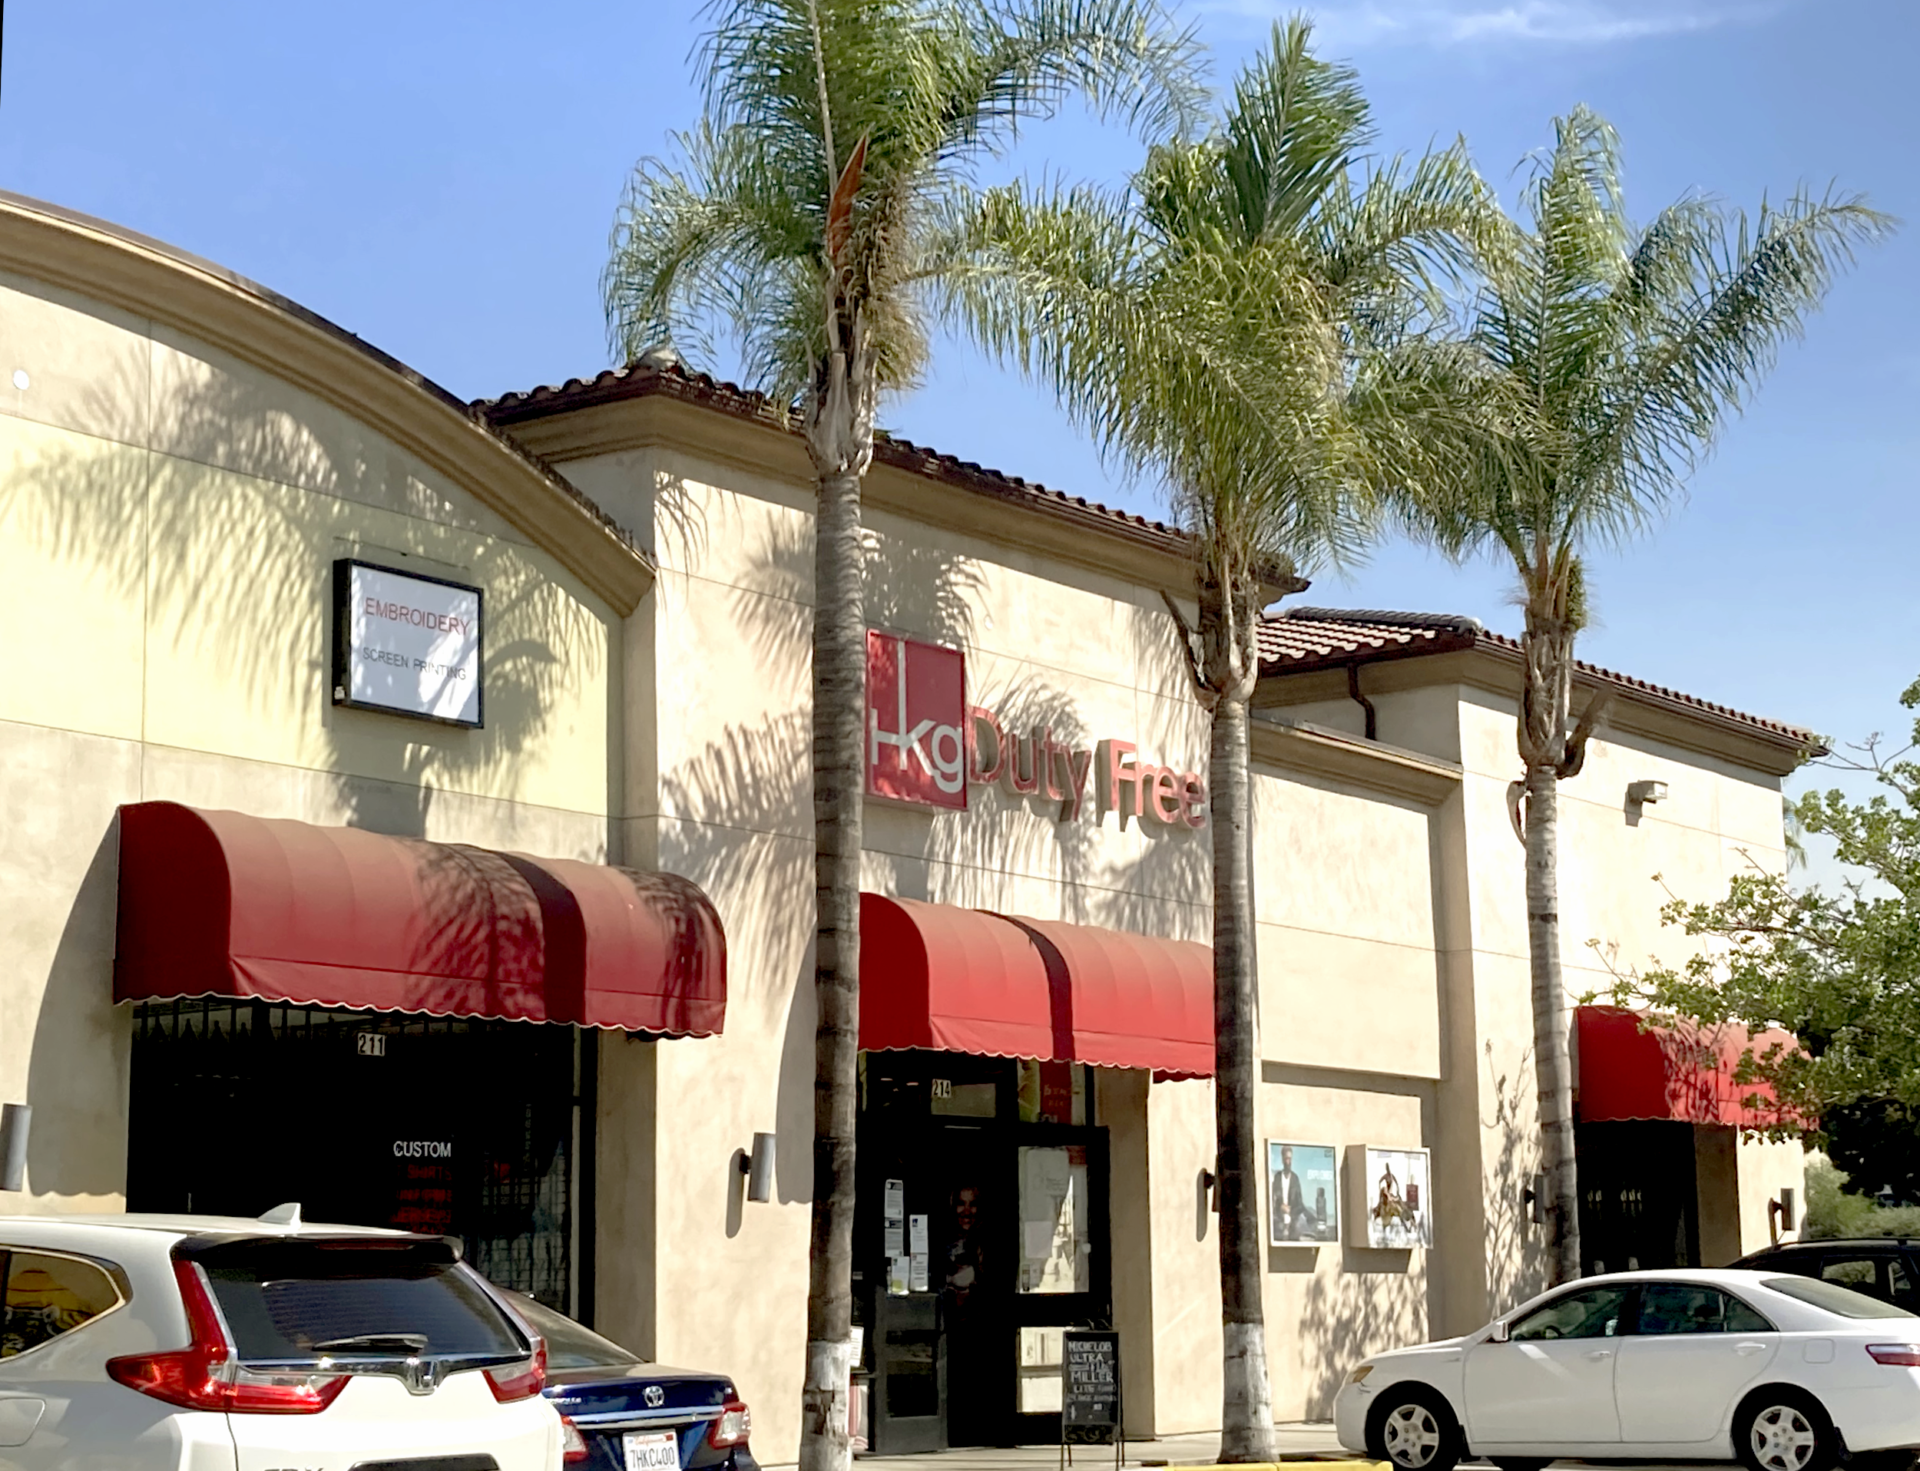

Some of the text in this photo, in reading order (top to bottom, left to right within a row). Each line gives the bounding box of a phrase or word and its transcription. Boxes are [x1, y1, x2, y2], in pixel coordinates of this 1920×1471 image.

[365, 597, 471, 636] EMBROIDERY
[362, 647, 467, 681] SCREEN PRINTING
[968, 705, 1206, 828] Duty Free
[359, 1034, 383, 1055] 211
[933, 1079, 950, 1097] 214
[393, 1140, 452, 1158] CUSTOM
[1070, 1370, 1114, 1383] MILLER
